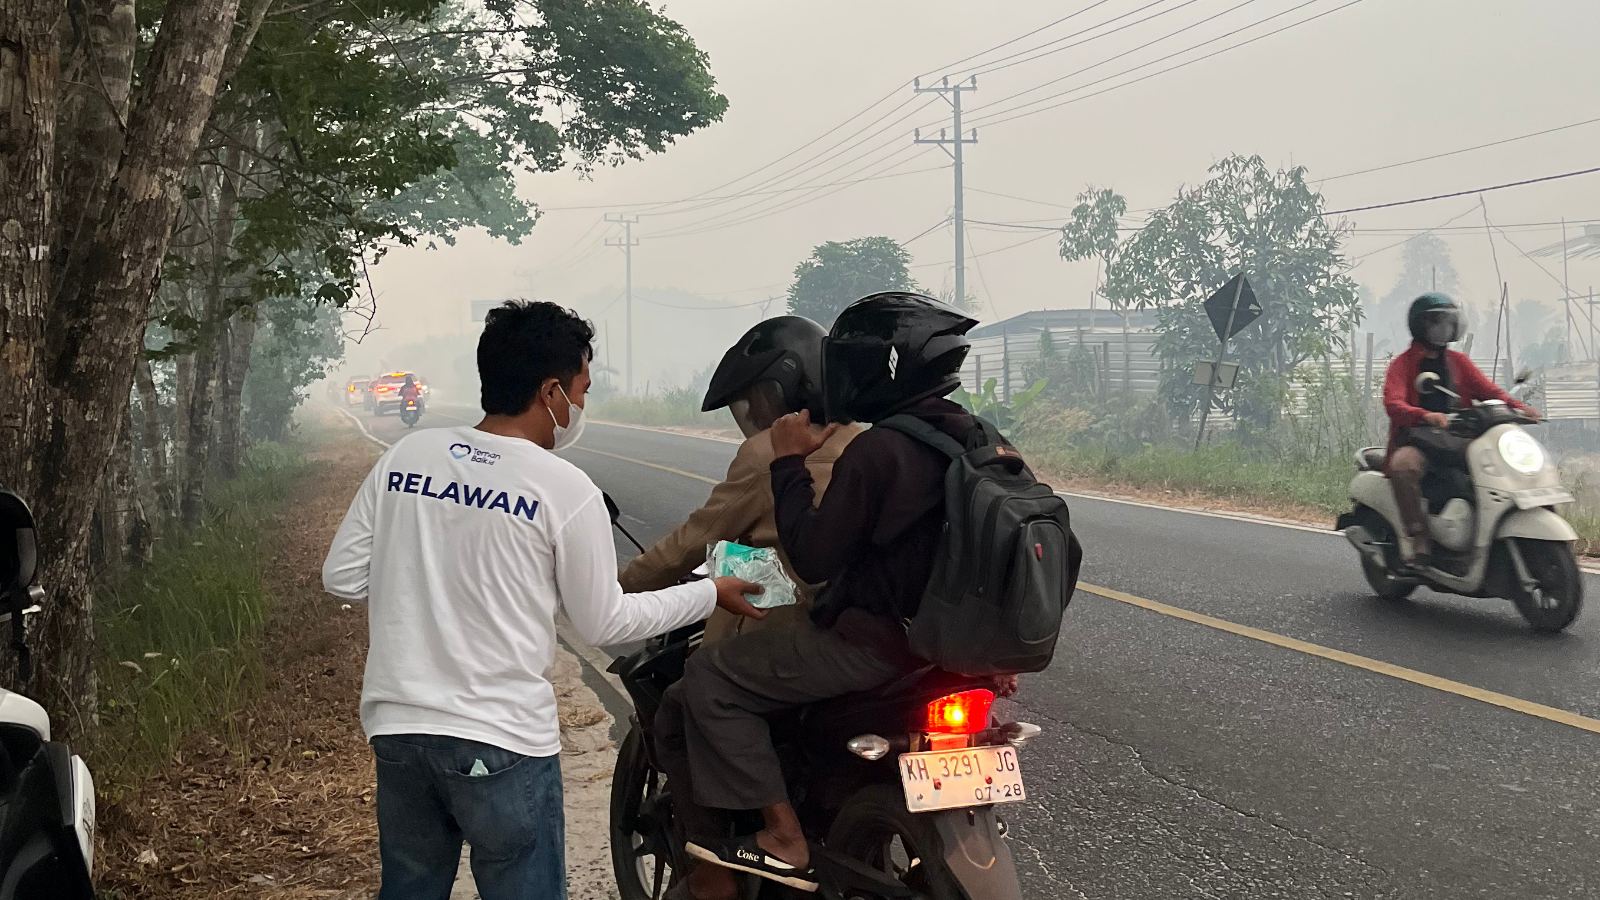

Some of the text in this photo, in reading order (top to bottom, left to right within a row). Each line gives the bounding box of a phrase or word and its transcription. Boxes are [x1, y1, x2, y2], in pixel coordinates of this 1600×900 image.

[473, 448, 501, 460] Teman
[387, 471, 539, 521] RELAWAN
[904, 751, 1015, 781] KH 3291 JG
[736, 849, 760, 862] Coke
